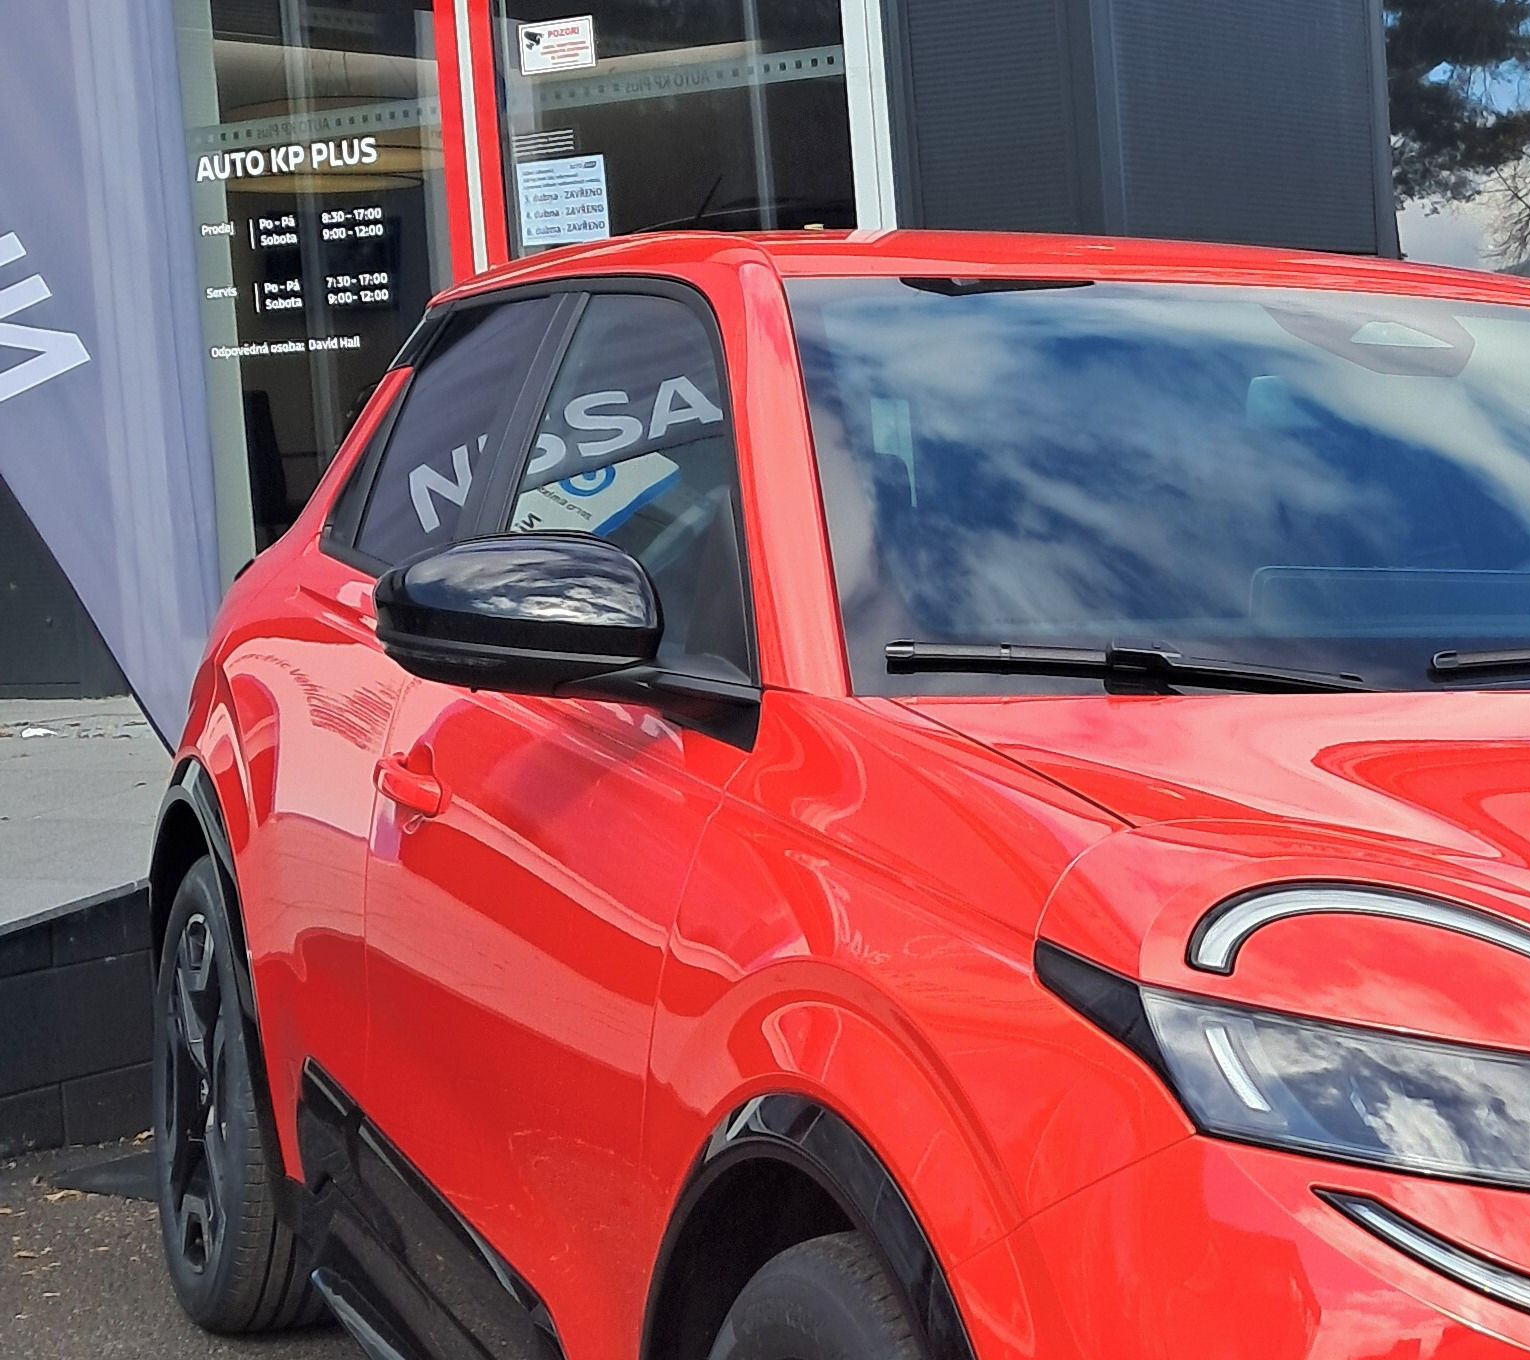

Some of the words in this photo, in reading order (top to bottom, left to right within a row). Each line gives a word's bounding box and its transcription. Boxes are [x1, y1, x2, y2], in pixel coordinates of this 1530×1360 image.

[197, 151, 264, 182] AUTO
[271, 145, 305, 173] KP
[311, 137, 377, 170] PLUS
[259, 218, 274, 230] Po
[281, 214, 295, 228] Pá
[321, 210, 345, 224] 8:30
[353, 207, 382, 221] 17:00
[260, 233, 298, 246] Sobota
[322, 227, 346, 240] 9:00
[354, 224, 384, 238] 12:00
[206, 285, 238, 299] Servis
[264, 282, 279, 294] Po
[286, 278, 300, 292] Pá
[358, 272, 388, 286] 17:00
[265, 297, 303, 310] Sobota
[360, 288, 389, 302] 12:00
[308, 336, 338, 351] David
